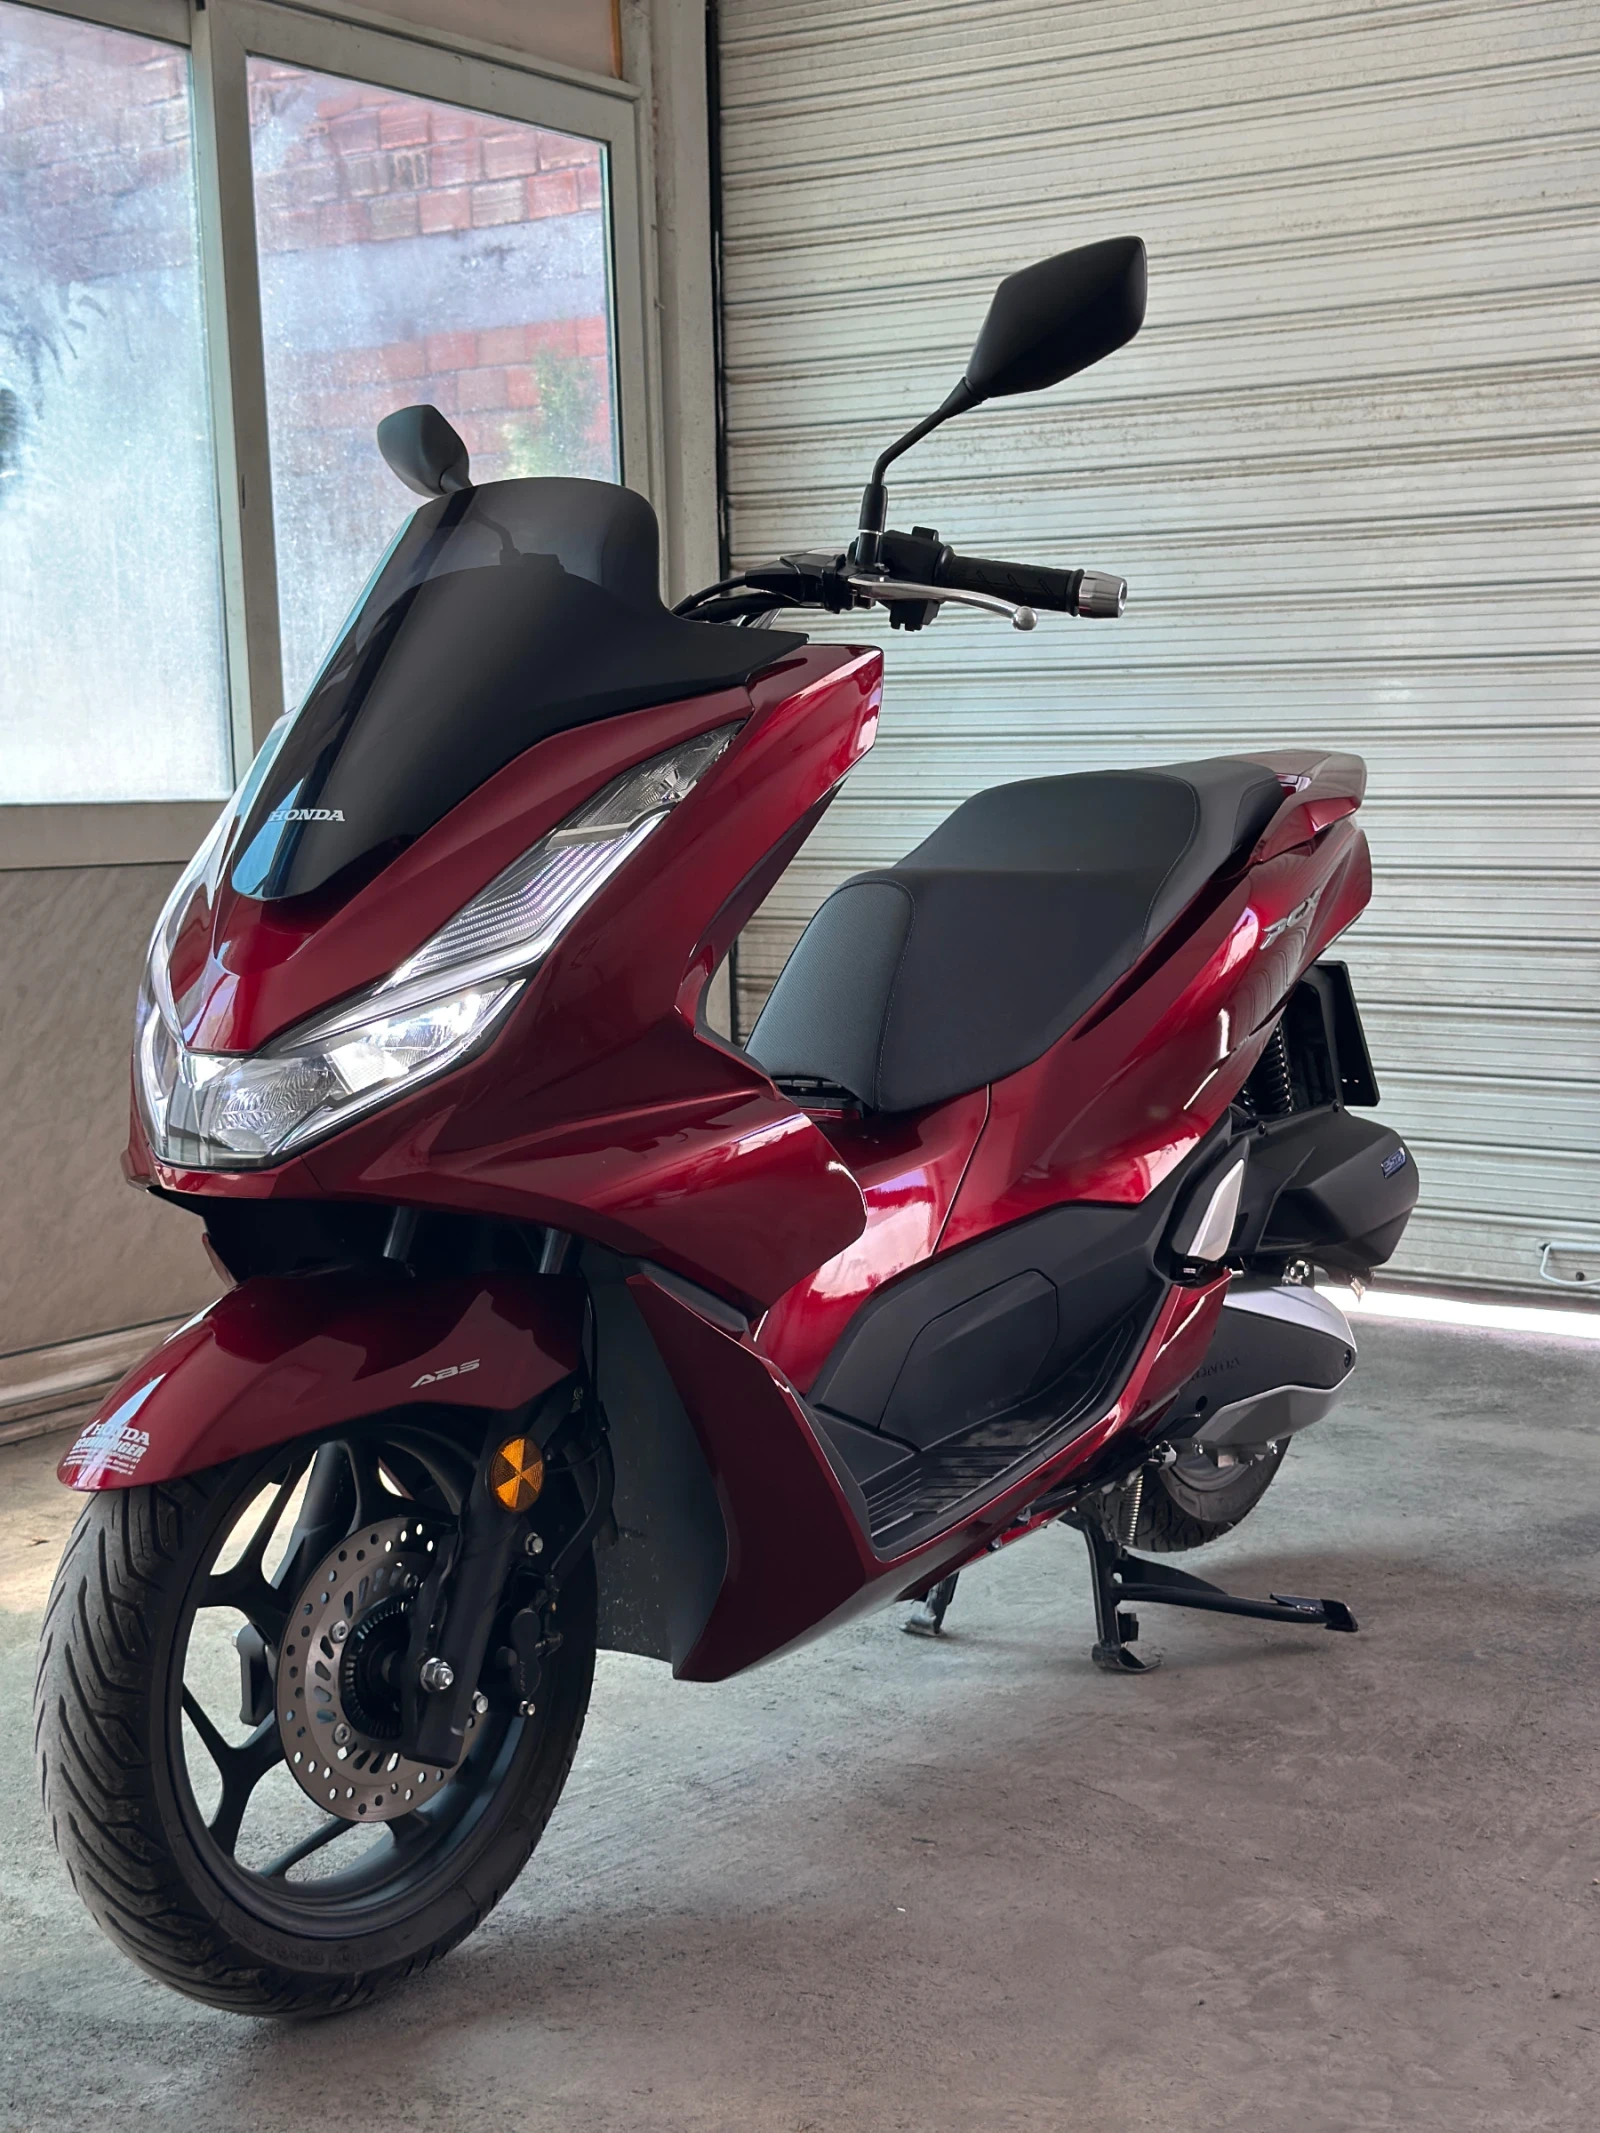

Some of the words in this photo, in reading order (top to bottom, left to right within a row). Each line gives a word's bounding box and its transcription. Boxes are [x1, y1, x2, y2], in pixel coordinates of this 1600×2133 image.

[267, 809, 345, 822] HONDA
[410, 1359, 480, 1388] ABS
[1191, 1357, 1240, 1380] ONDA
[91, 1423, 150, 1446] HONDA
